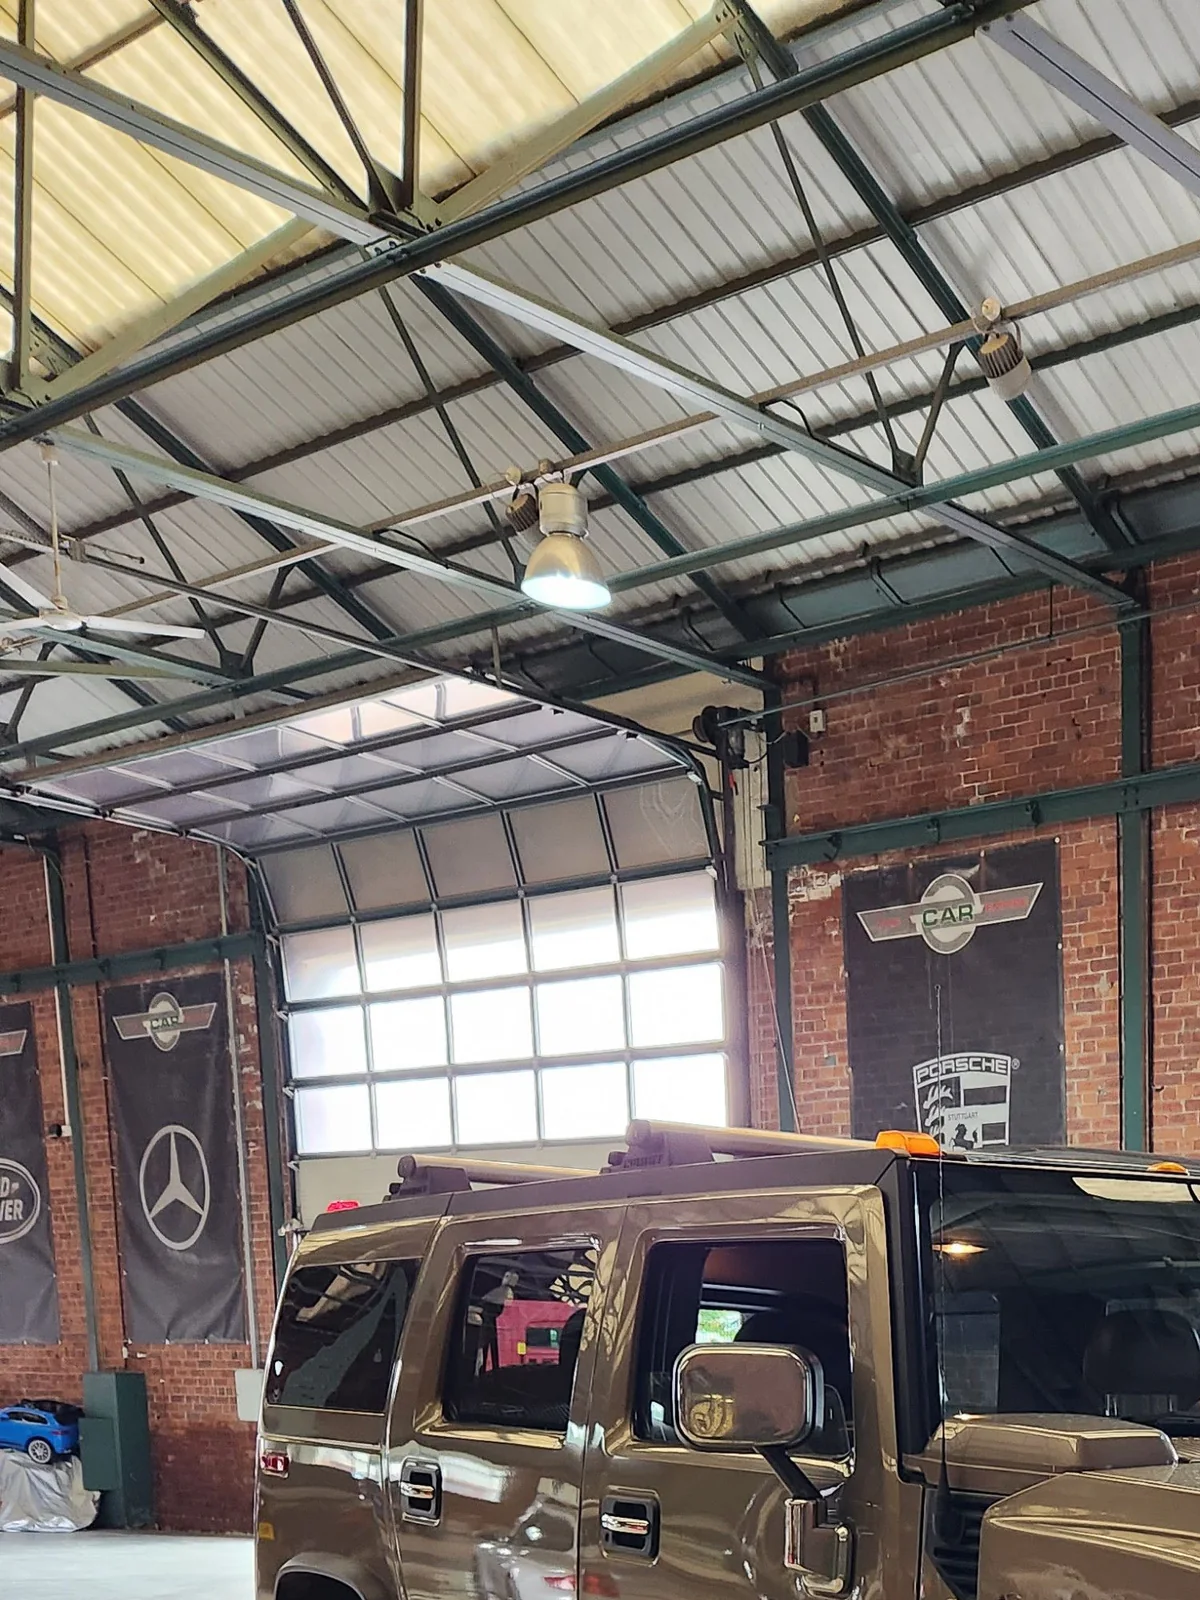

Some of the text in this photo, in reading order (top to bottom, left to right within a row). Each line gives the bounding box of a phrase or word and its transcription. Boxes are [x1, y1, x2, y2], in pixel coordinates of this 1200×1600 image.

[921, 902, 975, 930] CAR
[916, 1056, 1008, 1083] PORSCHE
[947, 1110, 980, 1121] STUTTGART
